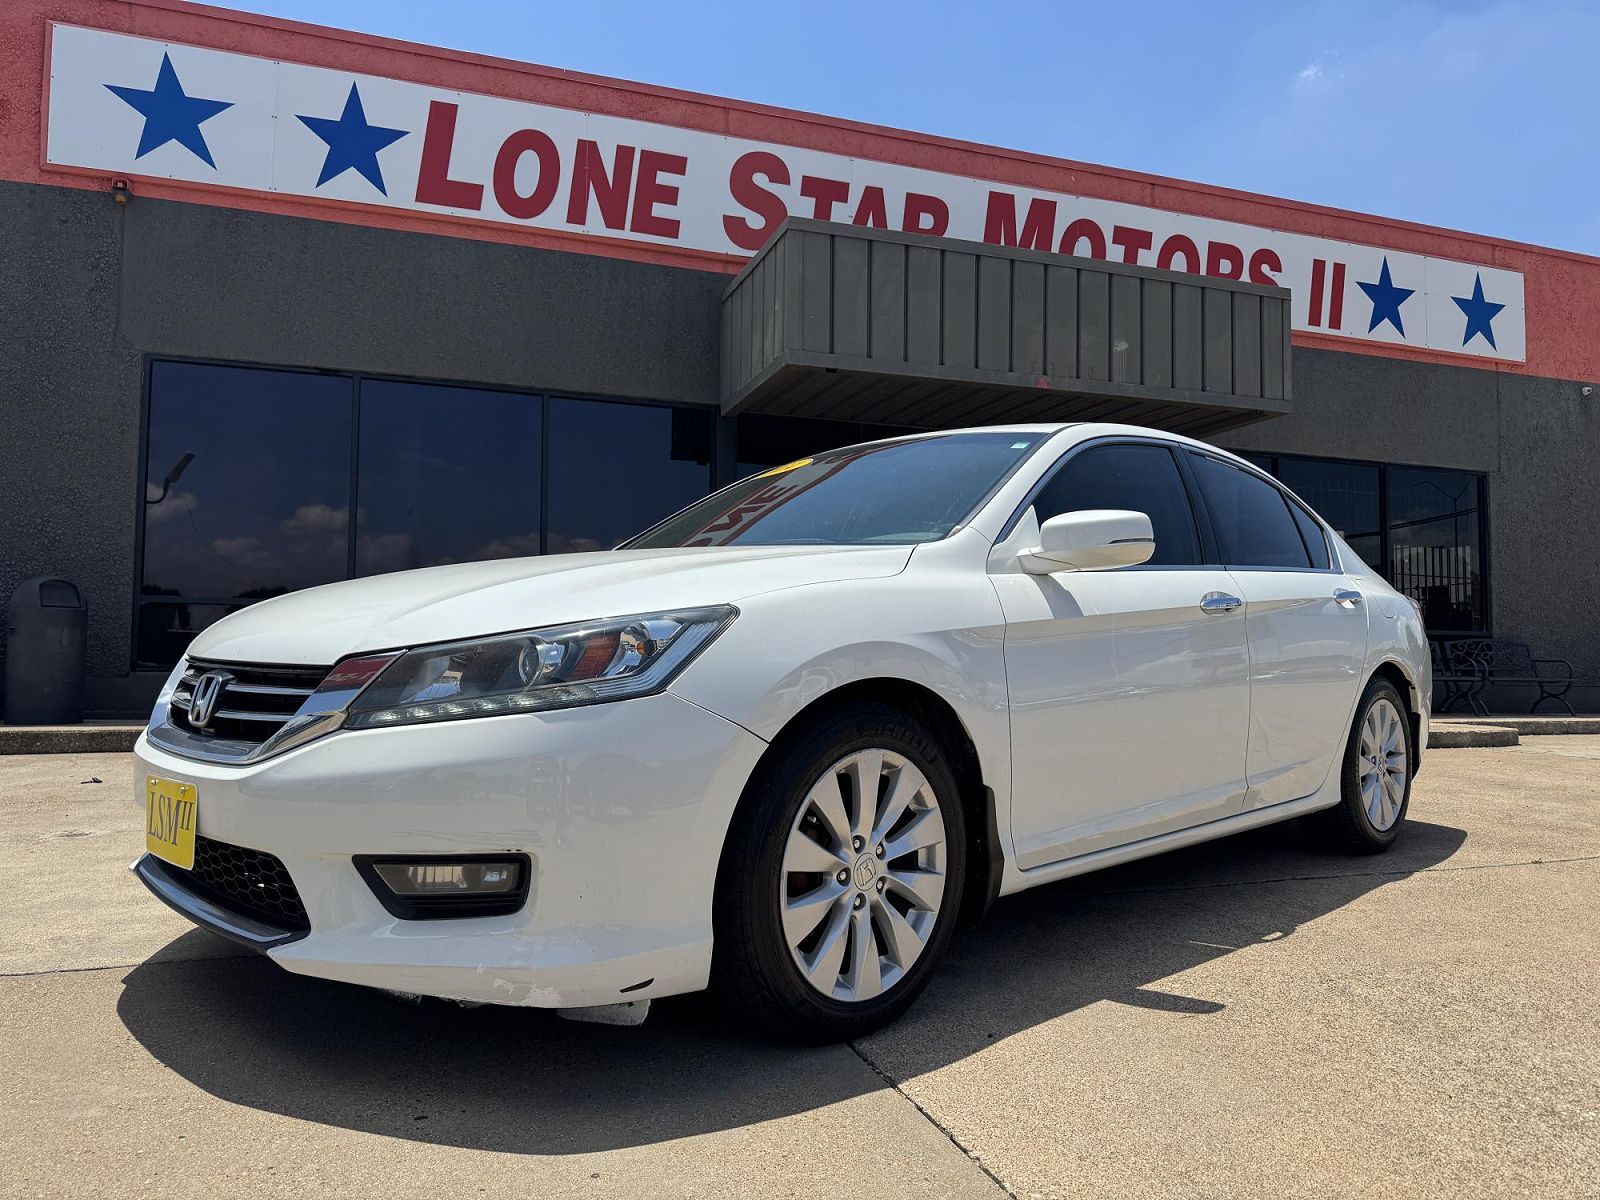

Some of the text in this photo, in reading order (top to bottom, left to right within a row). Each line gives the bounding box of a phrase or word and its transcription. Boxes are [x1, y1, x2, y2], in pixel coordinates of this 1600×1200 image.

[414, 100, 1346, 330] LONE STAR MOTORS II
